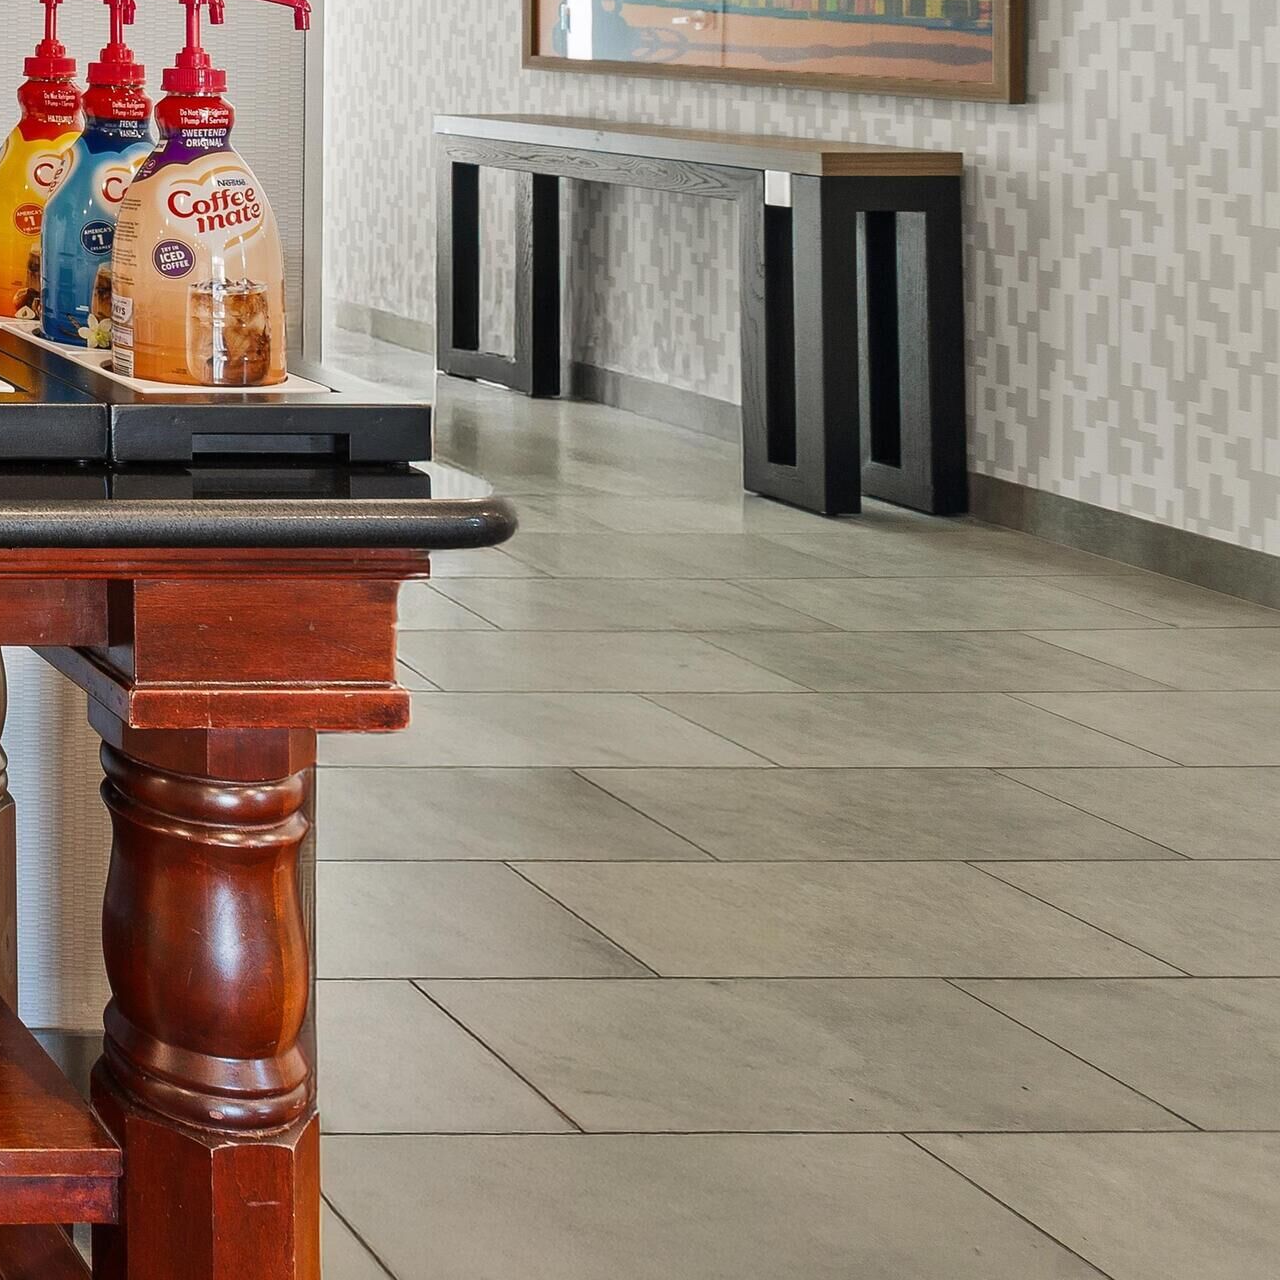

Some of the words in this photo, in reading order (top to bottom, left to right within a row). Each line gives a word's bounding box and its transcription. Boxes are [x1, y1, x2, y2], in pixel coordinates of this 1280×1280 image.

[209, 117, 228, 125] Serving
[181, 128, 227, 137] SWEETENED
[186, 138, 223, 148] ORIGINAL
[167, 187, 256, 218] Coffee
[196, 203, 261, 233] mate
[160, 251, 185, 263] ICED
[161, 260, 190, 271] COFFEE
